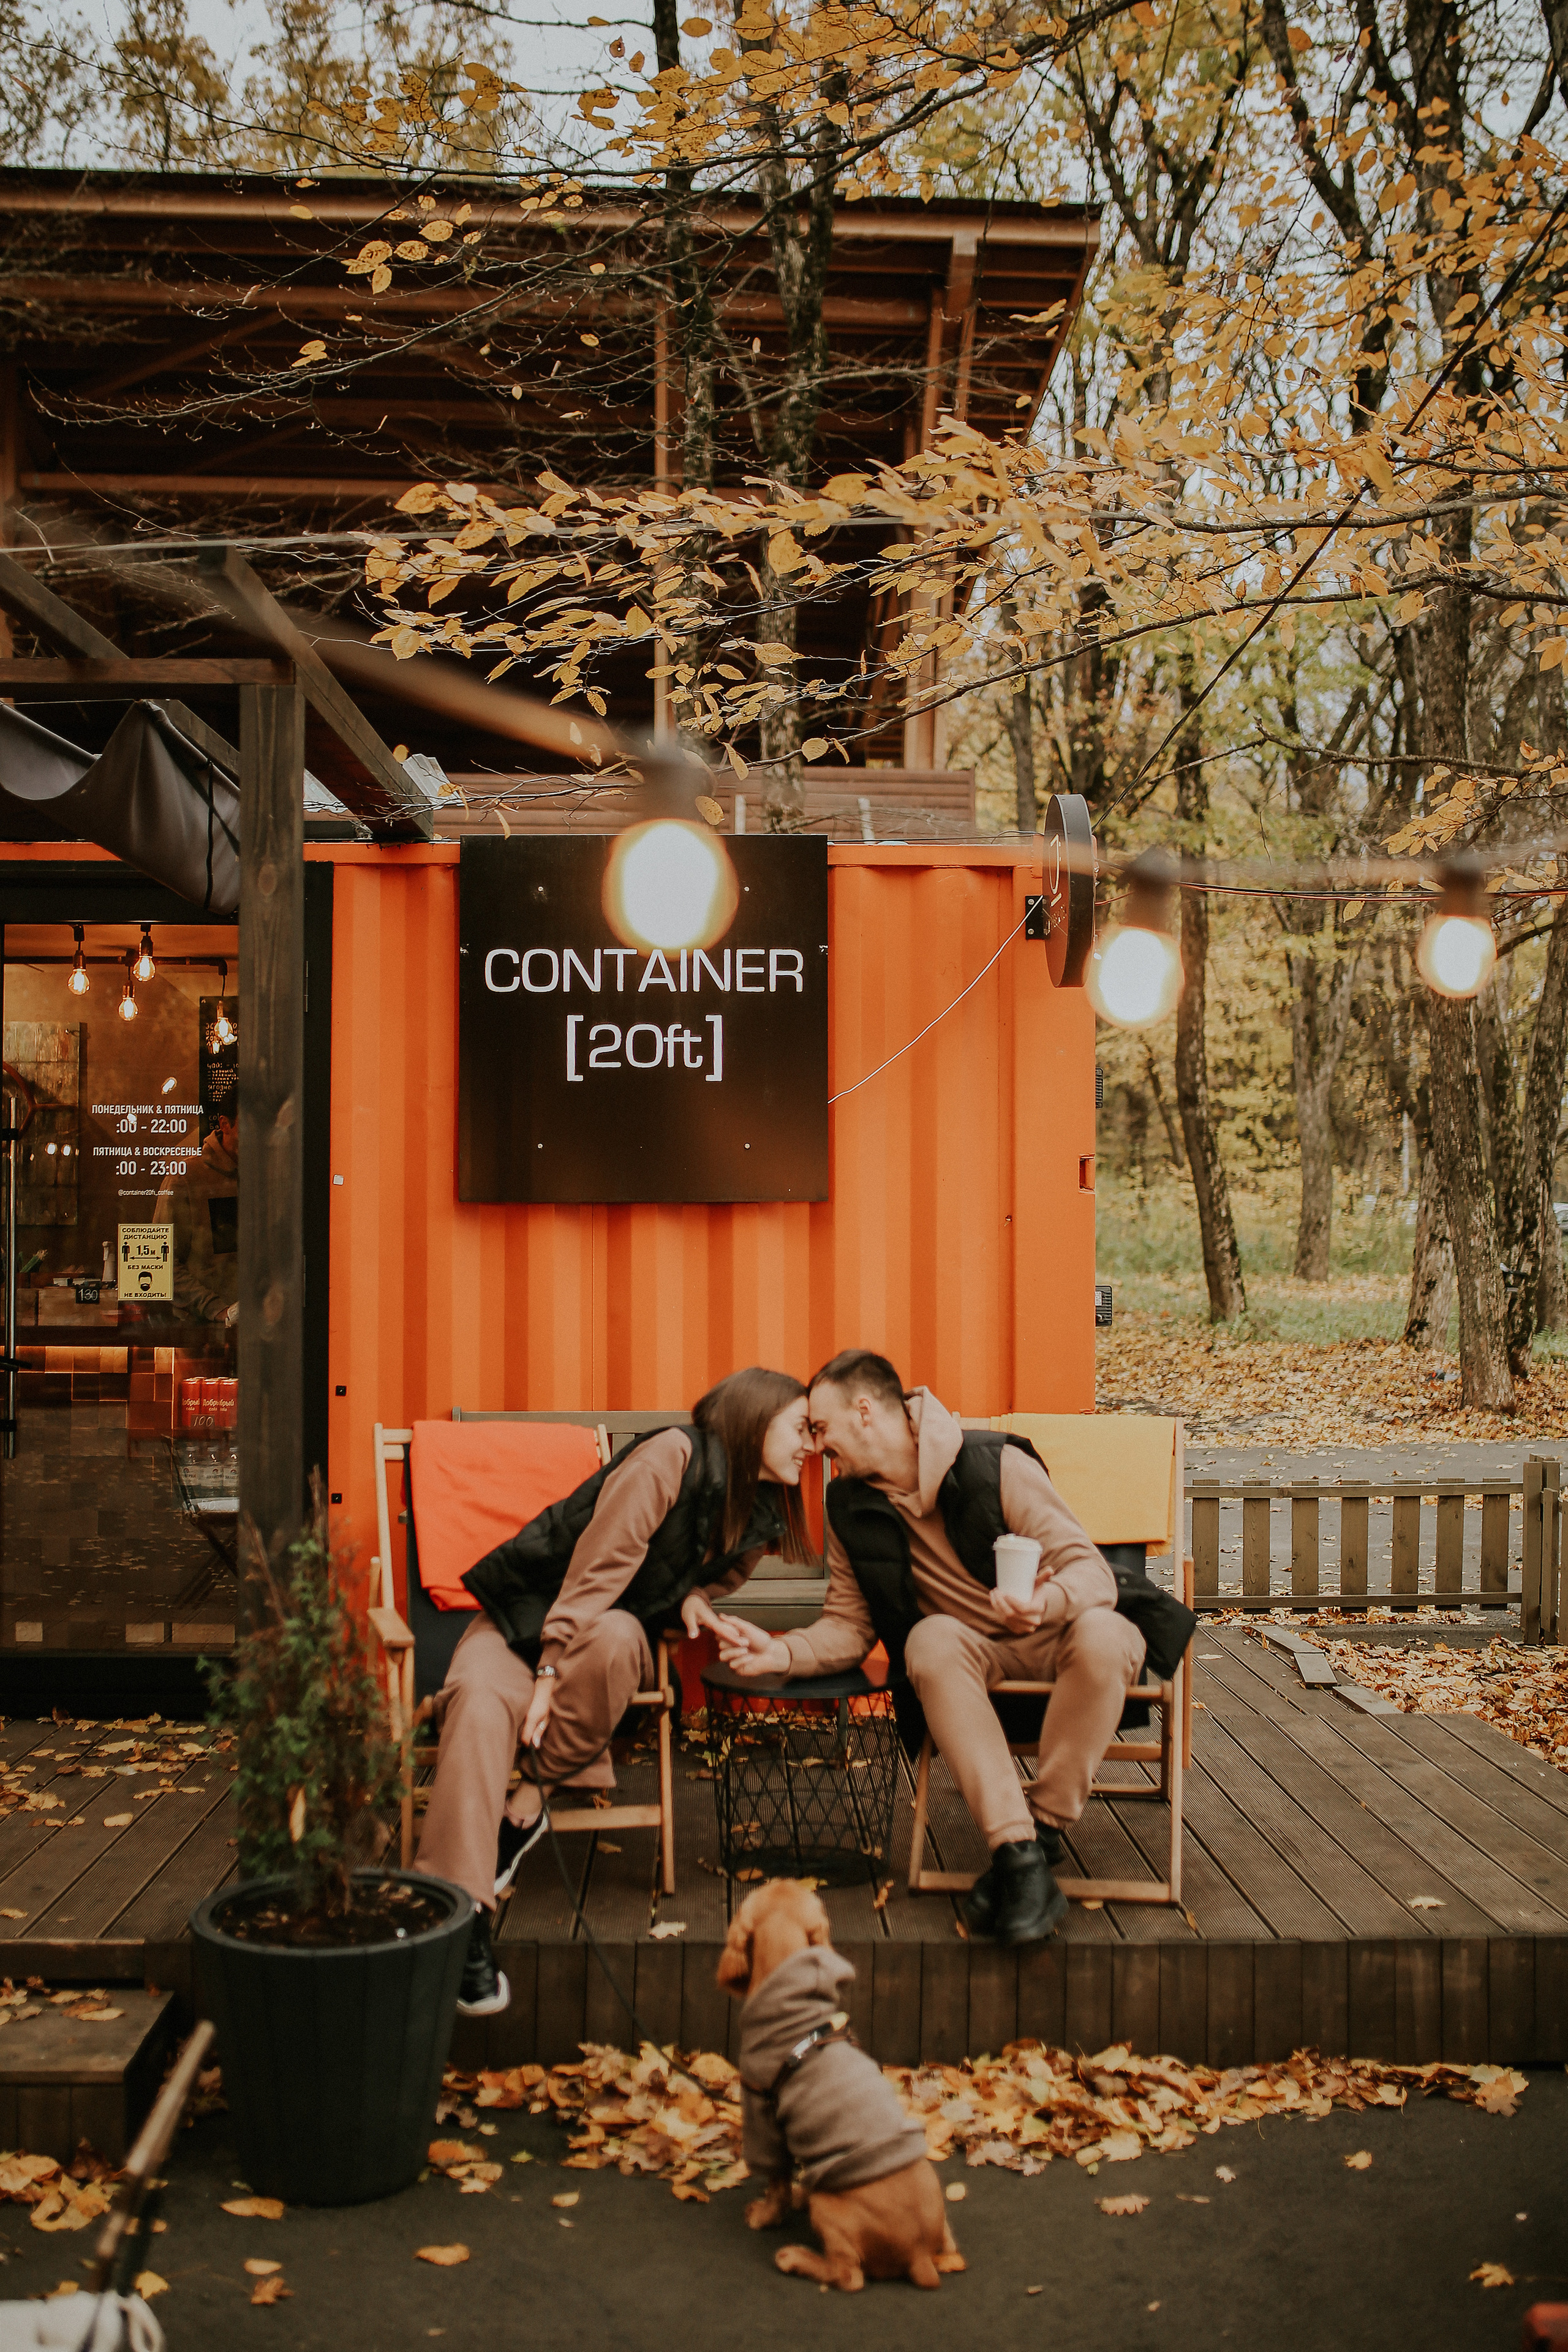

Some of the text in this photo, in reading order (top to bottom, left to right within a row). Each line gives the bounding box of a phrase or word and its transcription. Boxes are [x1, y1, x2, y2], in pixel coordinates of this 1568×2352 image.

[484, 948, 804, 993] CONTAINER
[566, 1014, 723, 1082] [20ft]
[92, 1104, 204, 1115] ПОНЕДЕЛЬНИК & ПЯТНИЦА
[150, 1118, 187, 1133] 22:00
[93, 1147, 203, 1157] ПЯТНИЦА & ВОСКРЕСЕНЬЕ
[149, 1160, 187, 1175] 23:00
[136, 1245, 150, 1256] 1,5
[78, 1288, 98, 1302] 130
[194, 1415, 213, 1427] 100
